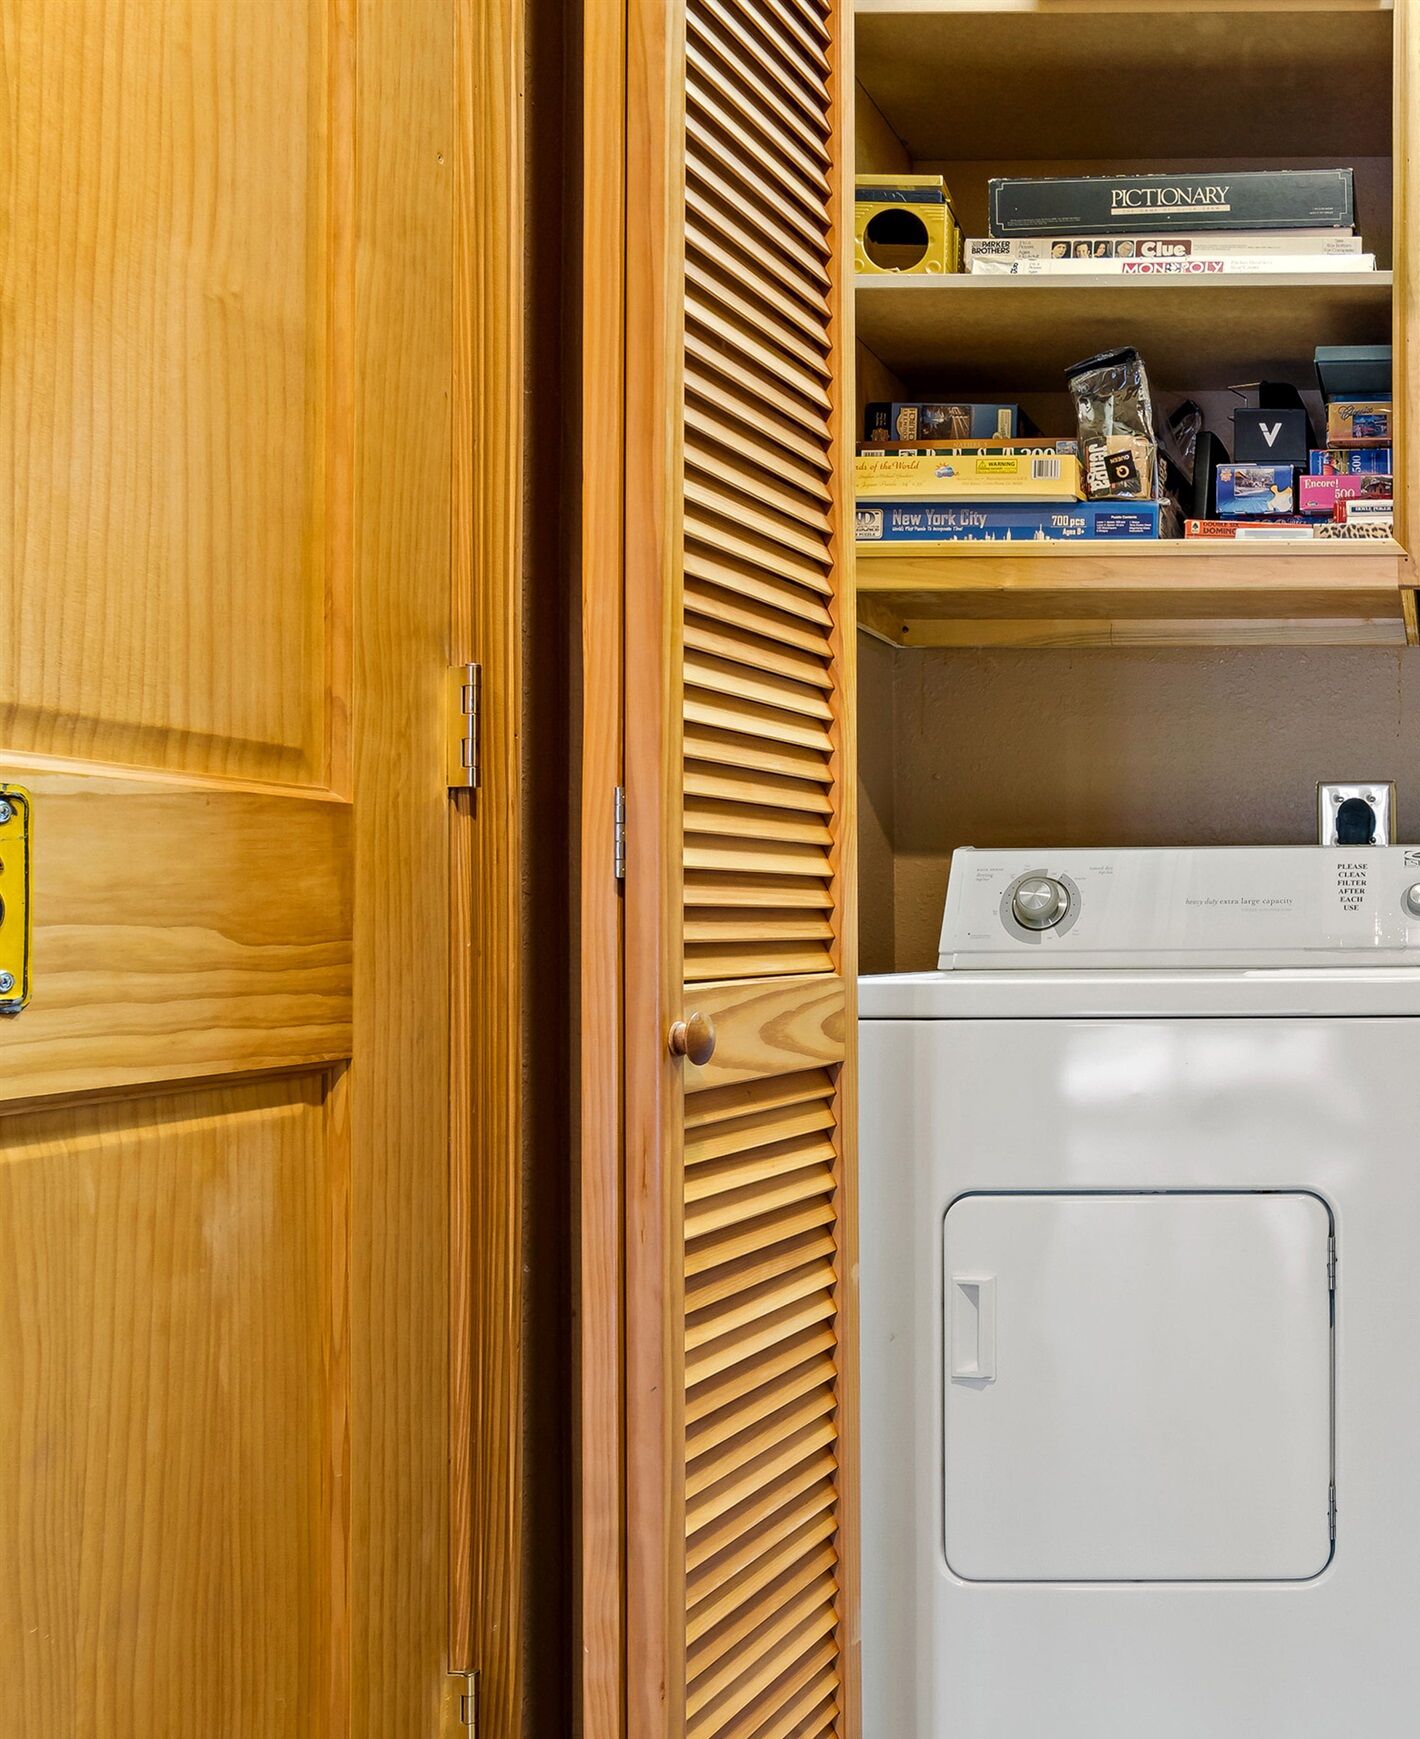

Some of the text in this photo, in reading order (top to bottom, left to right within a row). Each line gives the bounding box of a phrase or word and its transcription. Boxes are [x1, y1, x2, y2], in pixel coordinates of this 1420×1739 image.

[1111, 186, 1230, 207] PICTIONARY
[1141, 242, 1187, 257] Clue
[1122, 262, 1223, 273] MONOPOLY
[1110, 454, 1130, 464] QUEEN
[1352, 455, 1361, 473] 500
[880, 461, 892, 470] the
[893, 461, 920, 470] World
[1087, 443, 1110, 491] Jenga
[1116, 465, 1130, 478] Q
[1304, 479, 1339, 489] Encore!
[1334, 489, 1355, 499] 500
[892, 509, 987, 529] New York City
[1051, 515, 1069, 525] 700
[1070, 517, 1085, 527] pcs
[1062, 528, 1076, 536] Ages
[1240, 897, 1261, 906] large
[1262, 898, 1293, 906] capacity
